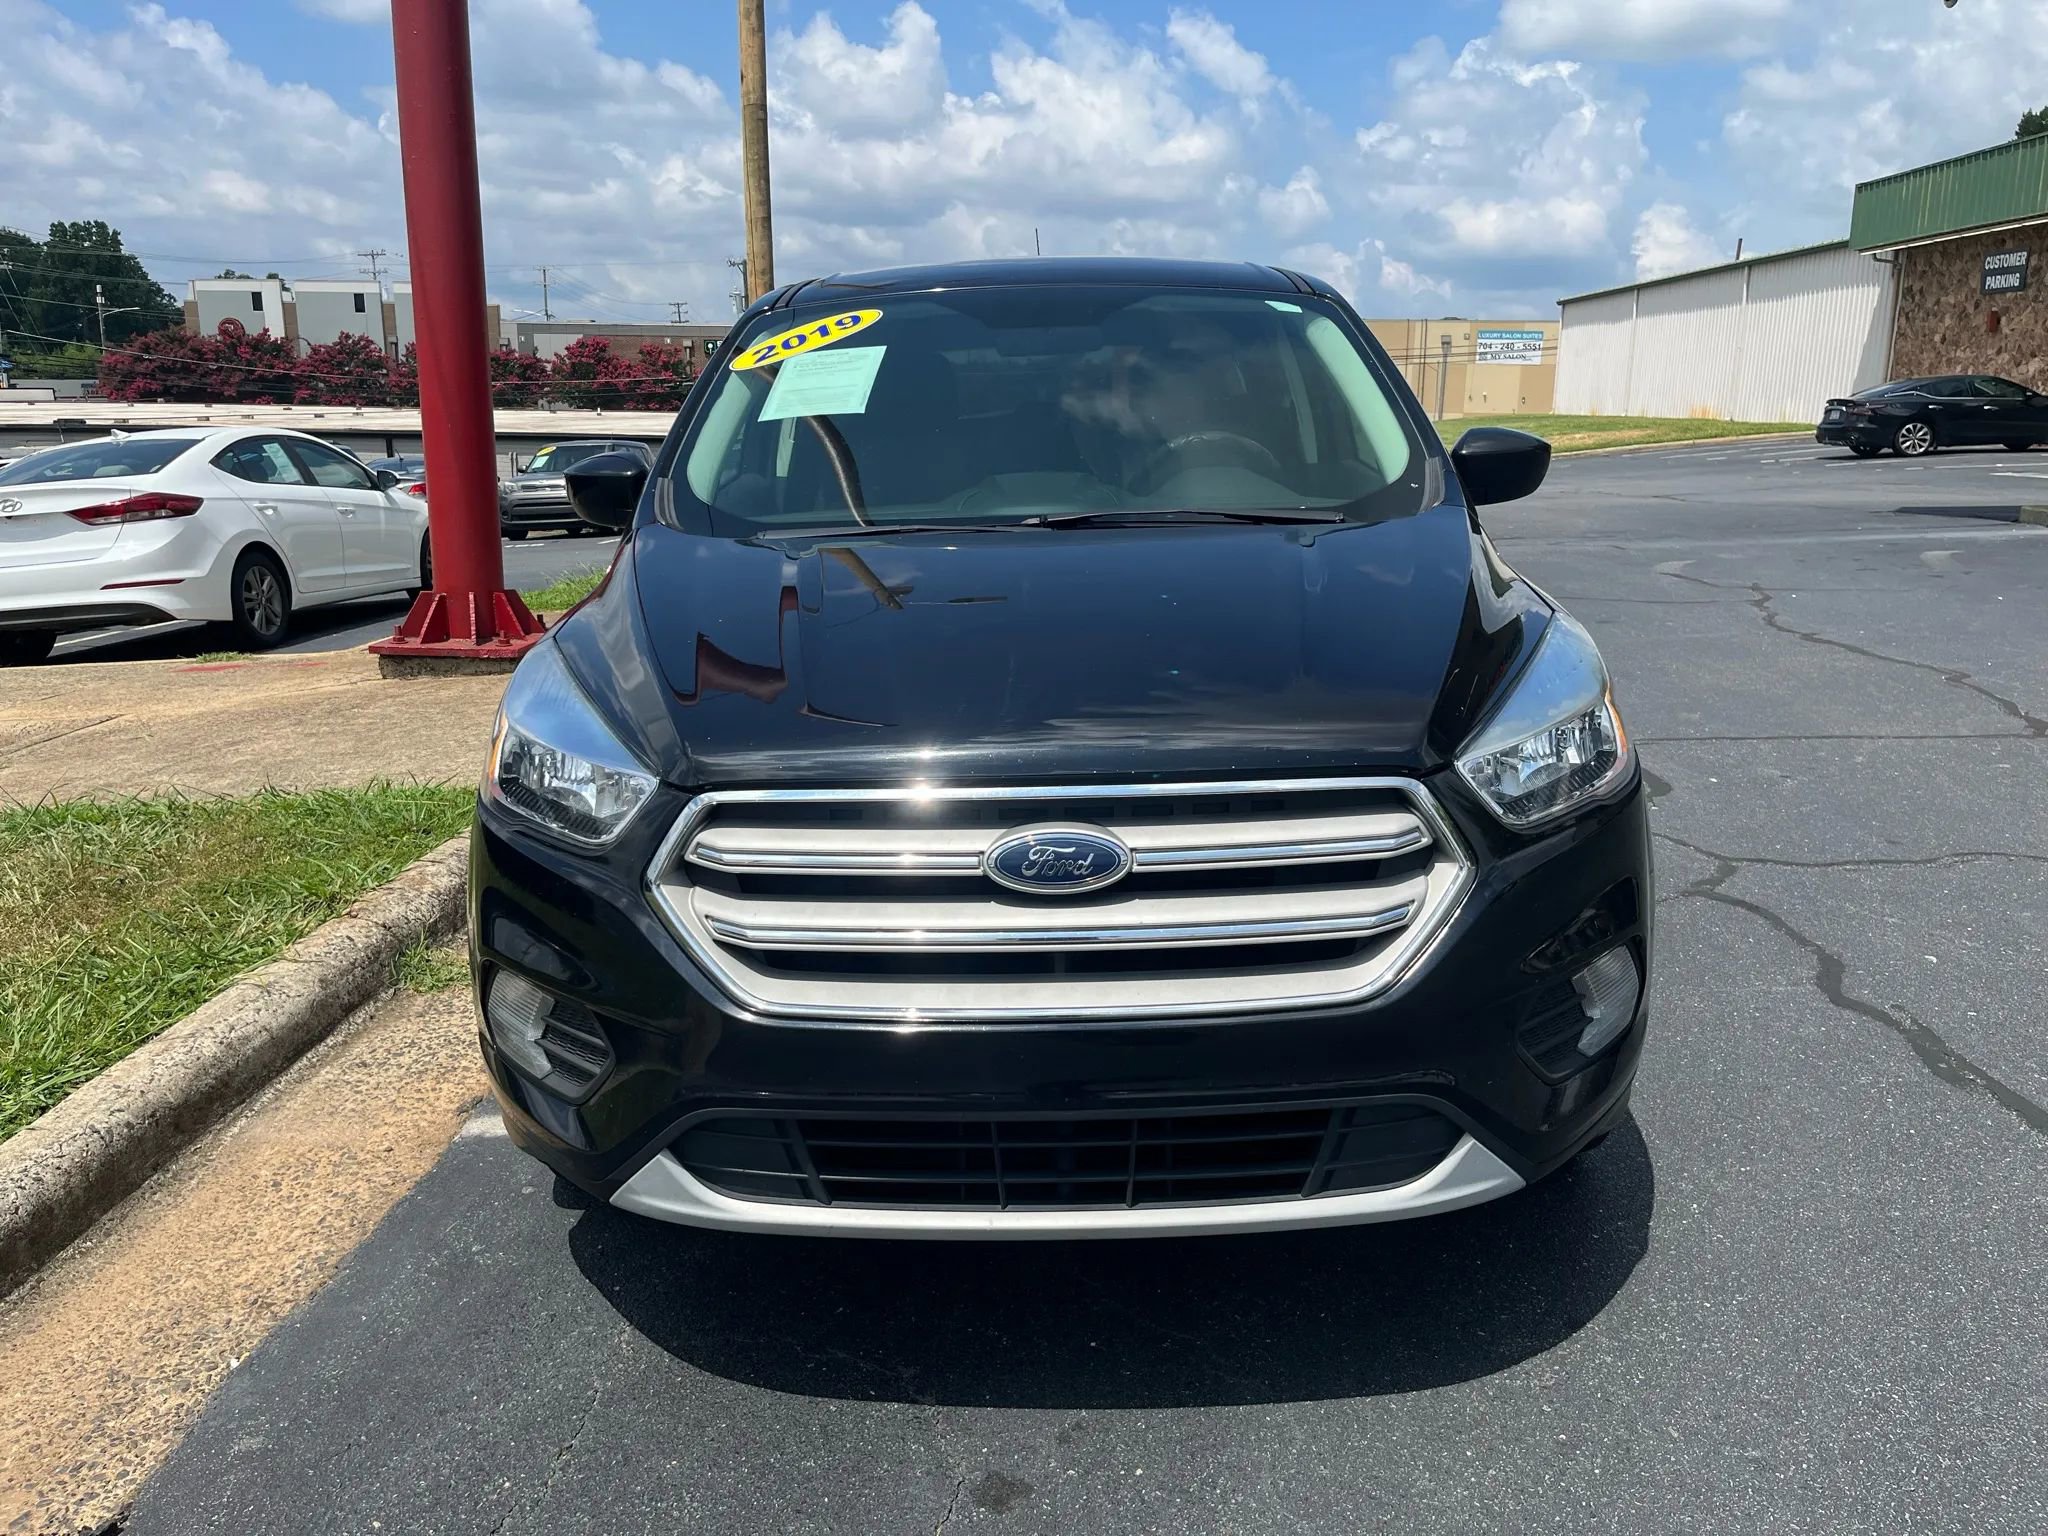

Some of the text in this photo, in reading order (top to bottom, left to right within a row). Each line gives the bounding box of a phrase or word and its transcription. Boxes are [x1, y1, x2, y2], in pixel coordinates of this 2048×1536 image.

[1984, 251, 2028, 270] CUSTOMER
[1985, 273, 2020, 290] PARKING
[752, 314, 862, 365] 2019
[1478, 342, 1493, 350] 704
[1500, 342, 1515, 350] 240
[1522, 343, 1541, 351] 5551
[1490, 352, 1501, 360] MY
[1021, 845, 1095, 877] Ford
